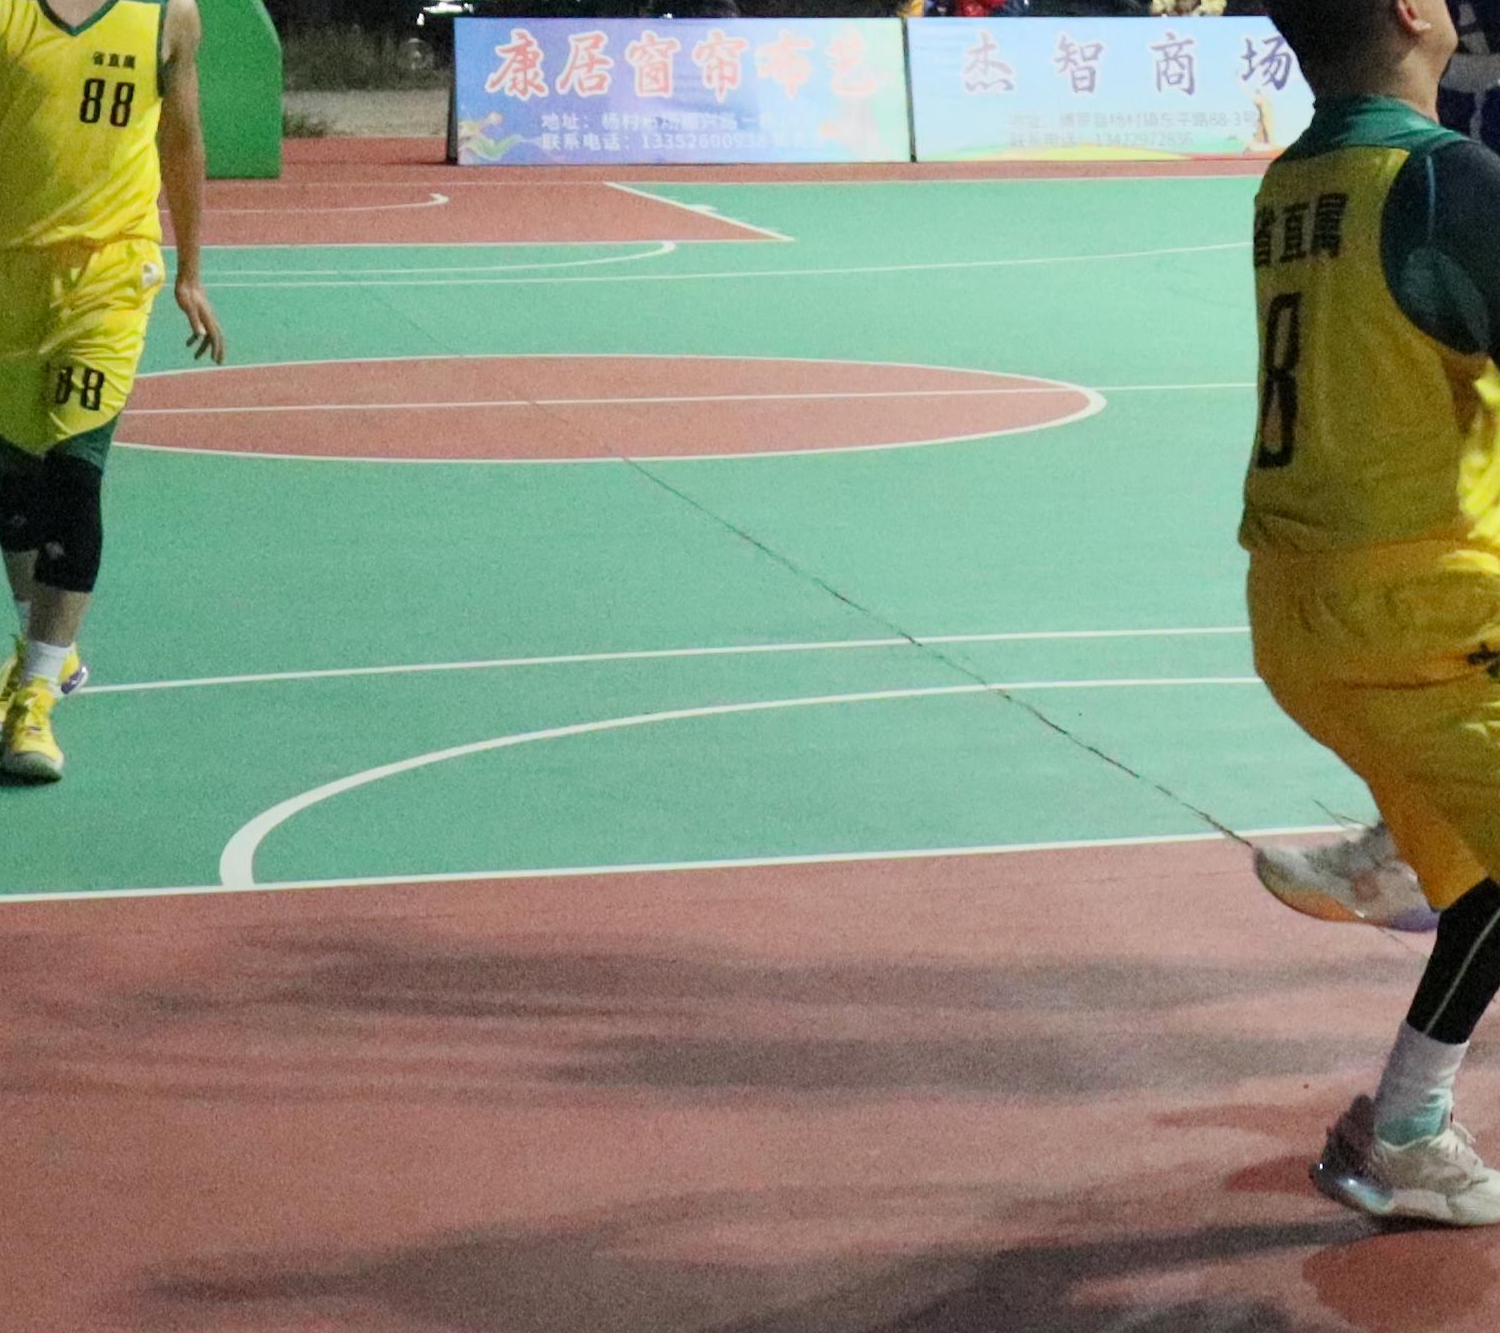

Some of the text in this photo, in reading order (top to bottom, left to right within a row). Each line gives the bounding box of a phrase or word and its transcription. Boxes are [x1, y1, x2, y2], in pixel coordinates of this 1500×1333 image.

[485, 28, 886, 102] 康居窗帘布艺
[963, 31, 1294, 96] 杰智商场
[80, 78, 135, 128] 88
[1257, 292, 1302, 469] 8
